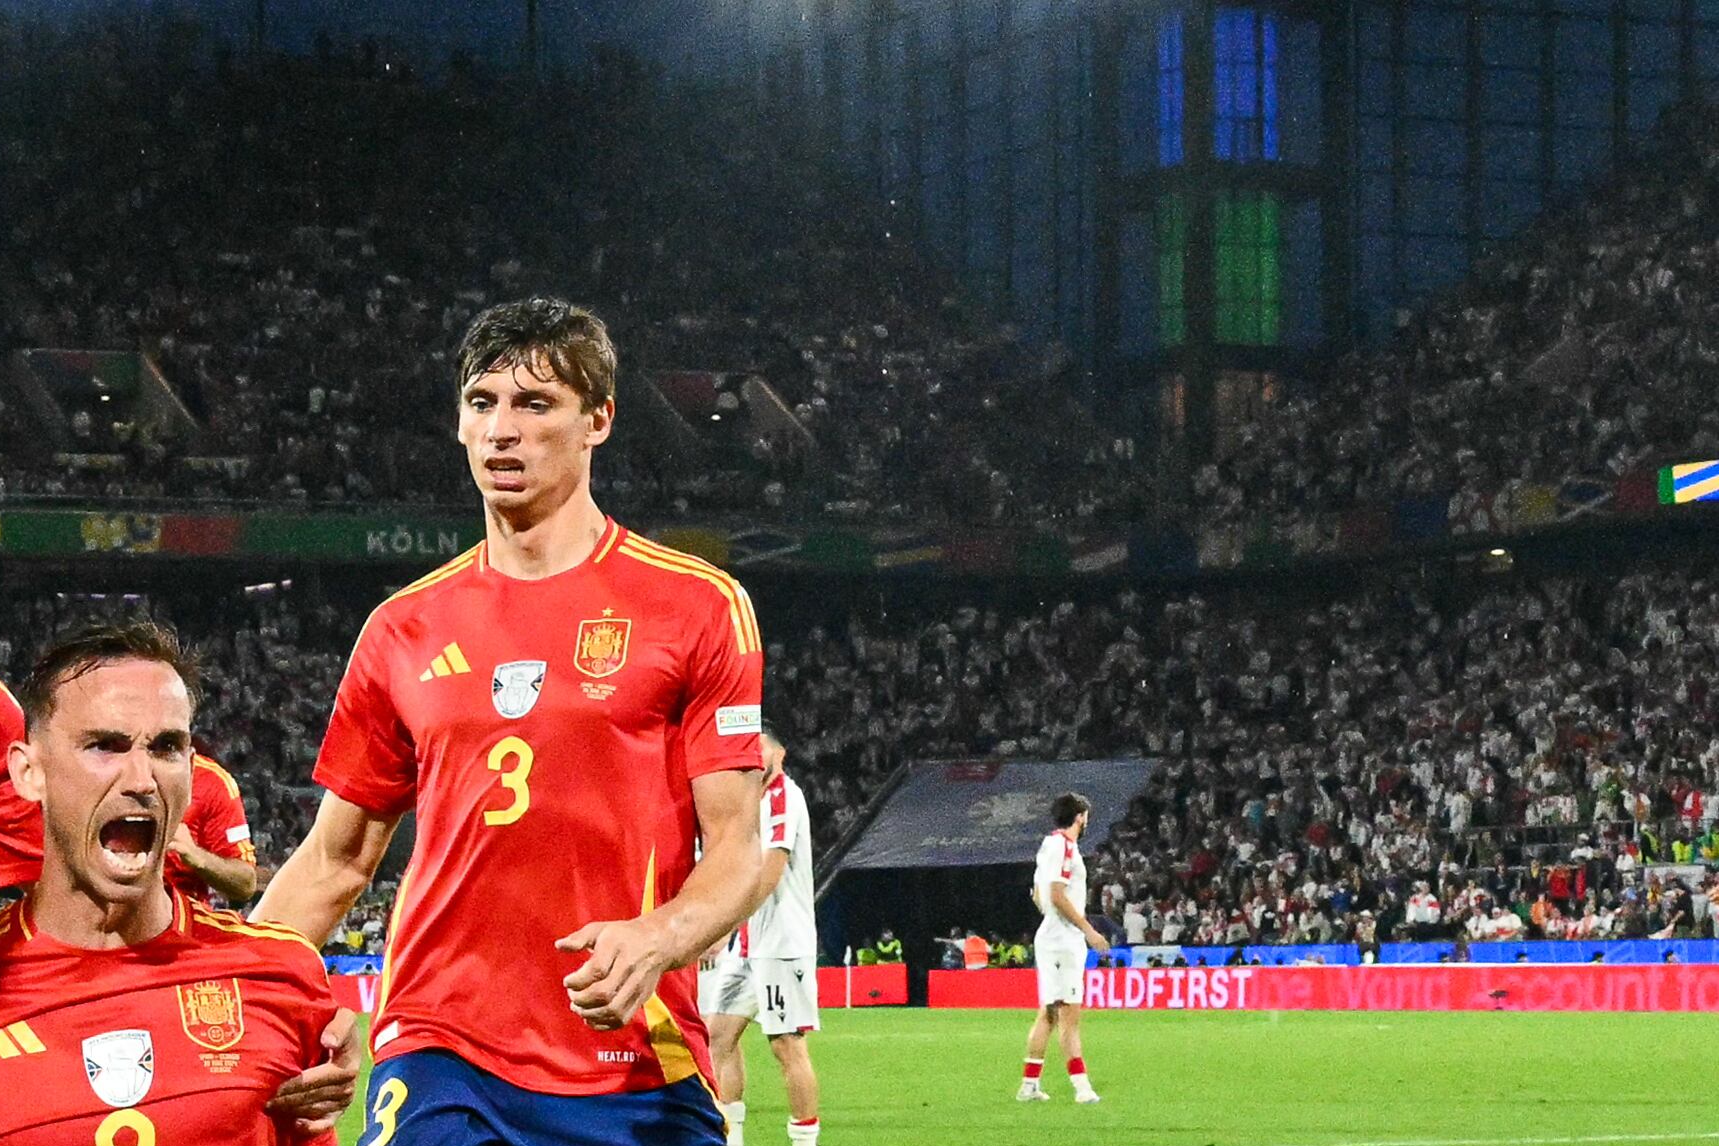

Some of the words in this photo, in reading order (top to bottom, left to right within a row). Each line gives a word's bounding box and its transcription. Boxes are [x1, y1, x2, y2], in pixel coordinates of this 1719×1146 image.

[366, 525, 458, 554] KÖLN
[483, 735, 534, 826] 3
[766, 985, 785, 1011] 14
[1086, 968, 1253, 1009] RLDFIRST
